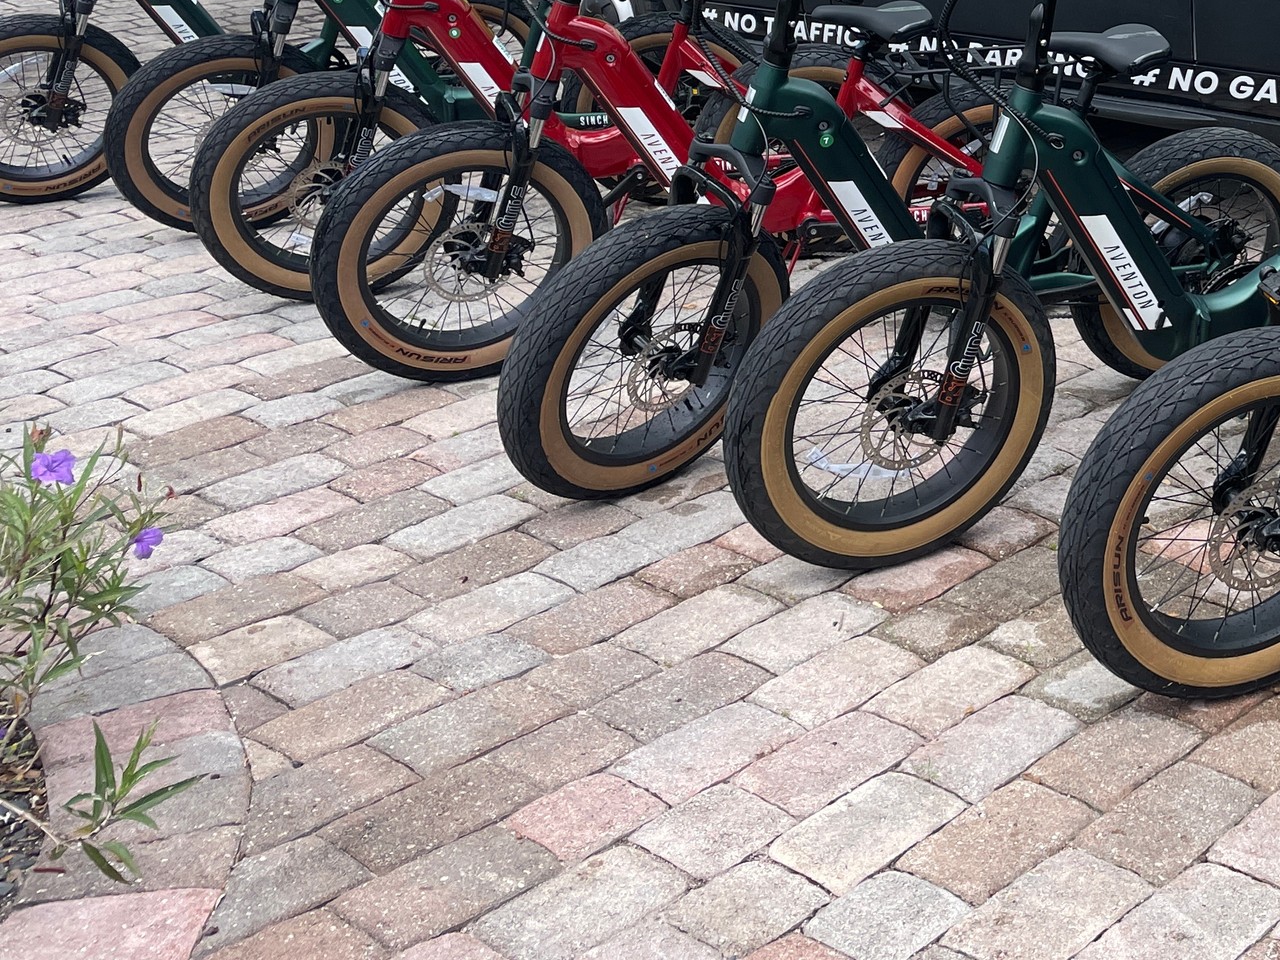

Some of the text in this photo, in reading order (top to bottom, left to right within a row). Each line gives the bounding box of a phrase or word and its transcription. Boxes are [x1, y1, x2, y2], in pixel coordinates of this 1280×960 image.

[724, 11, 757, 33] NO
[763, 16, 862, 47] TAFFIC
[1167, 67, 1219, 95] NO
[579, 114, 608, 127] SINCH
[640, 133, 679, 171] AVENT
[44, 163, 101, 192] ARISUN
[851, 208, 890, 245] AVEN
[1103, 244, 1155, 310] AVENTON
[394, 347, 469, 364] ARISUN
[1112, 534, 1133, 622] ARISUN
